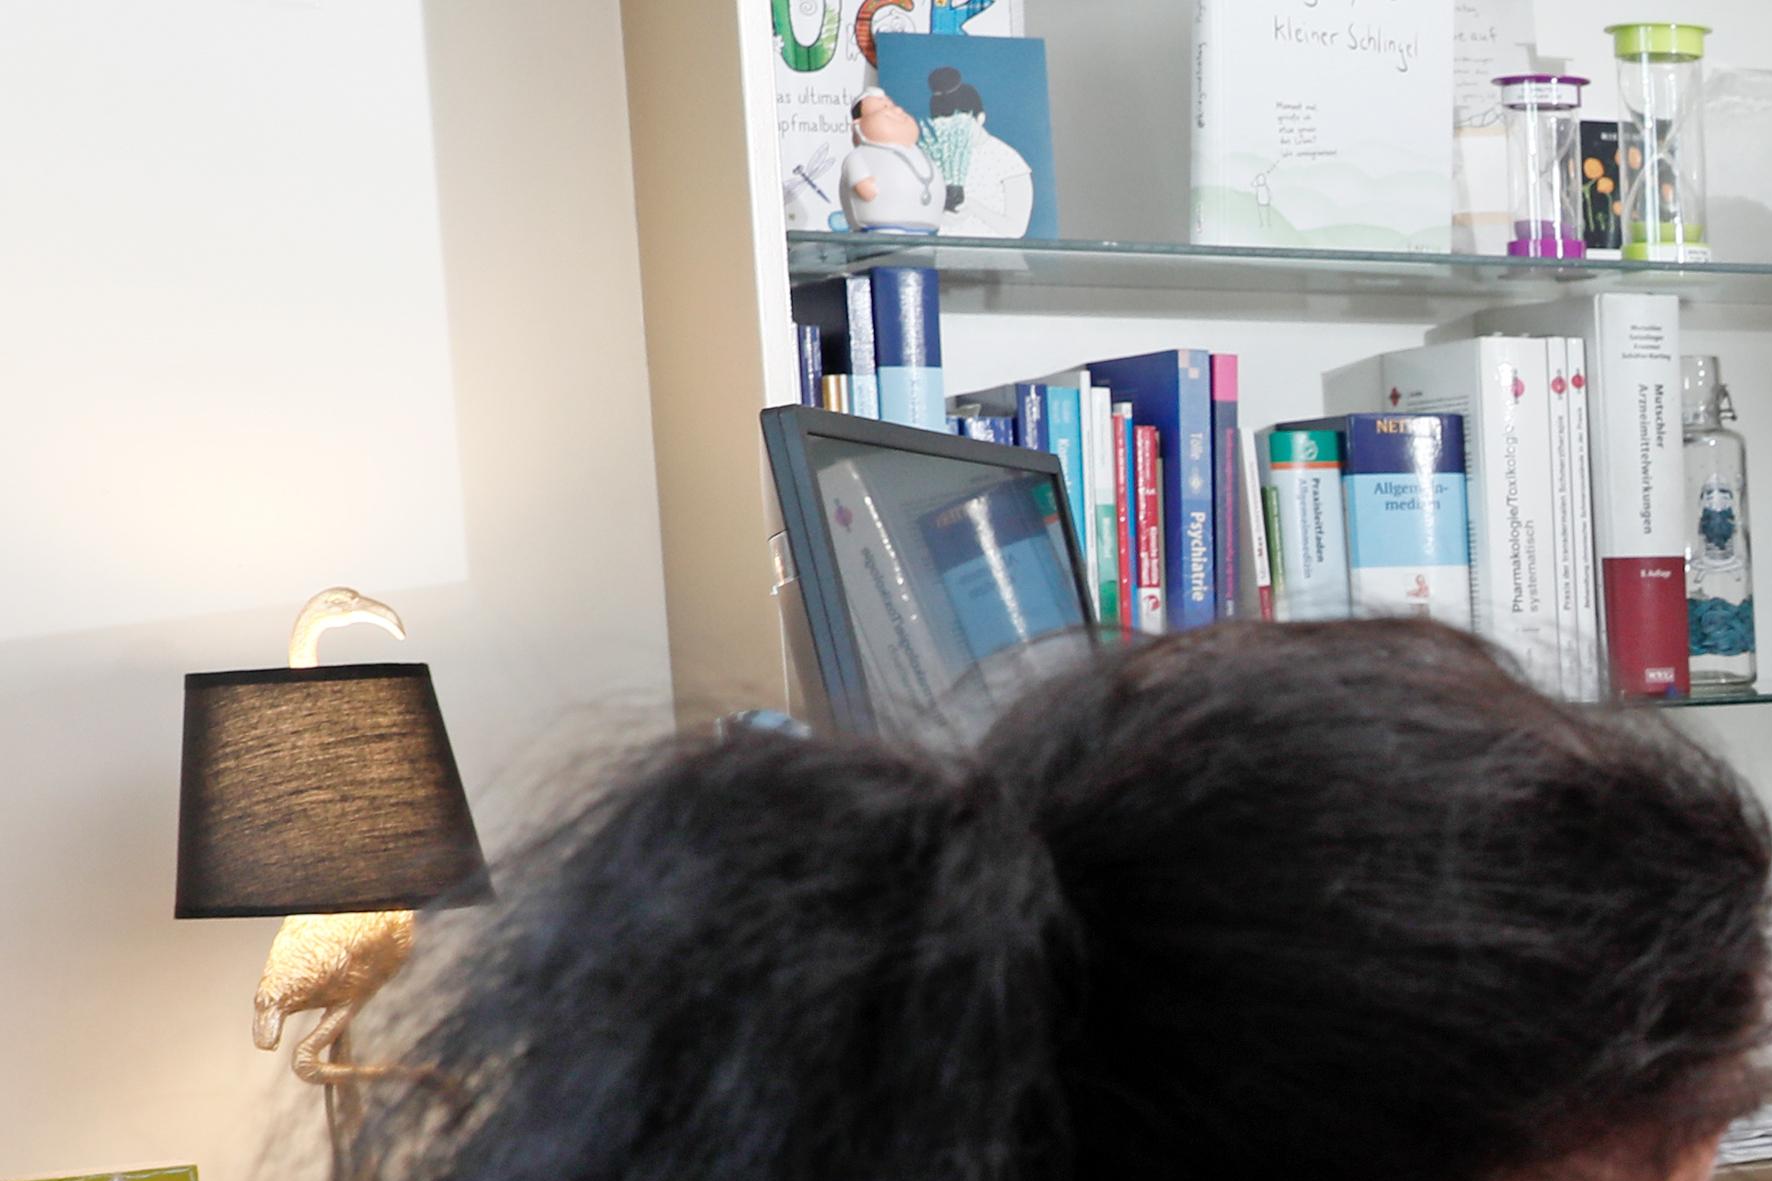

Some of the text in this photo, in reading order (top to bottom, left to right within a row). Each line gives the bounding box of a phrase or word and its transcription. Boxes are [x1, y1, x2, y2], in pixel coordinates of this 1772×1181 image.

[1347, 22, 1419, 72] Schlingel
[1654, 383, 1667, 449] Mutschler
[1373, 481, 1449, 498] Allgemn-
[1637, 383, 1653, 535] Arzneimittelwirkungen
[1311, 477, 1325, 563] Praxisleitfaden
[1385, 497, 1441, 511] medin
[1186, 511, 1209, 602] Psychiatrie
[1524, 519, 1541, 613] systematisch
